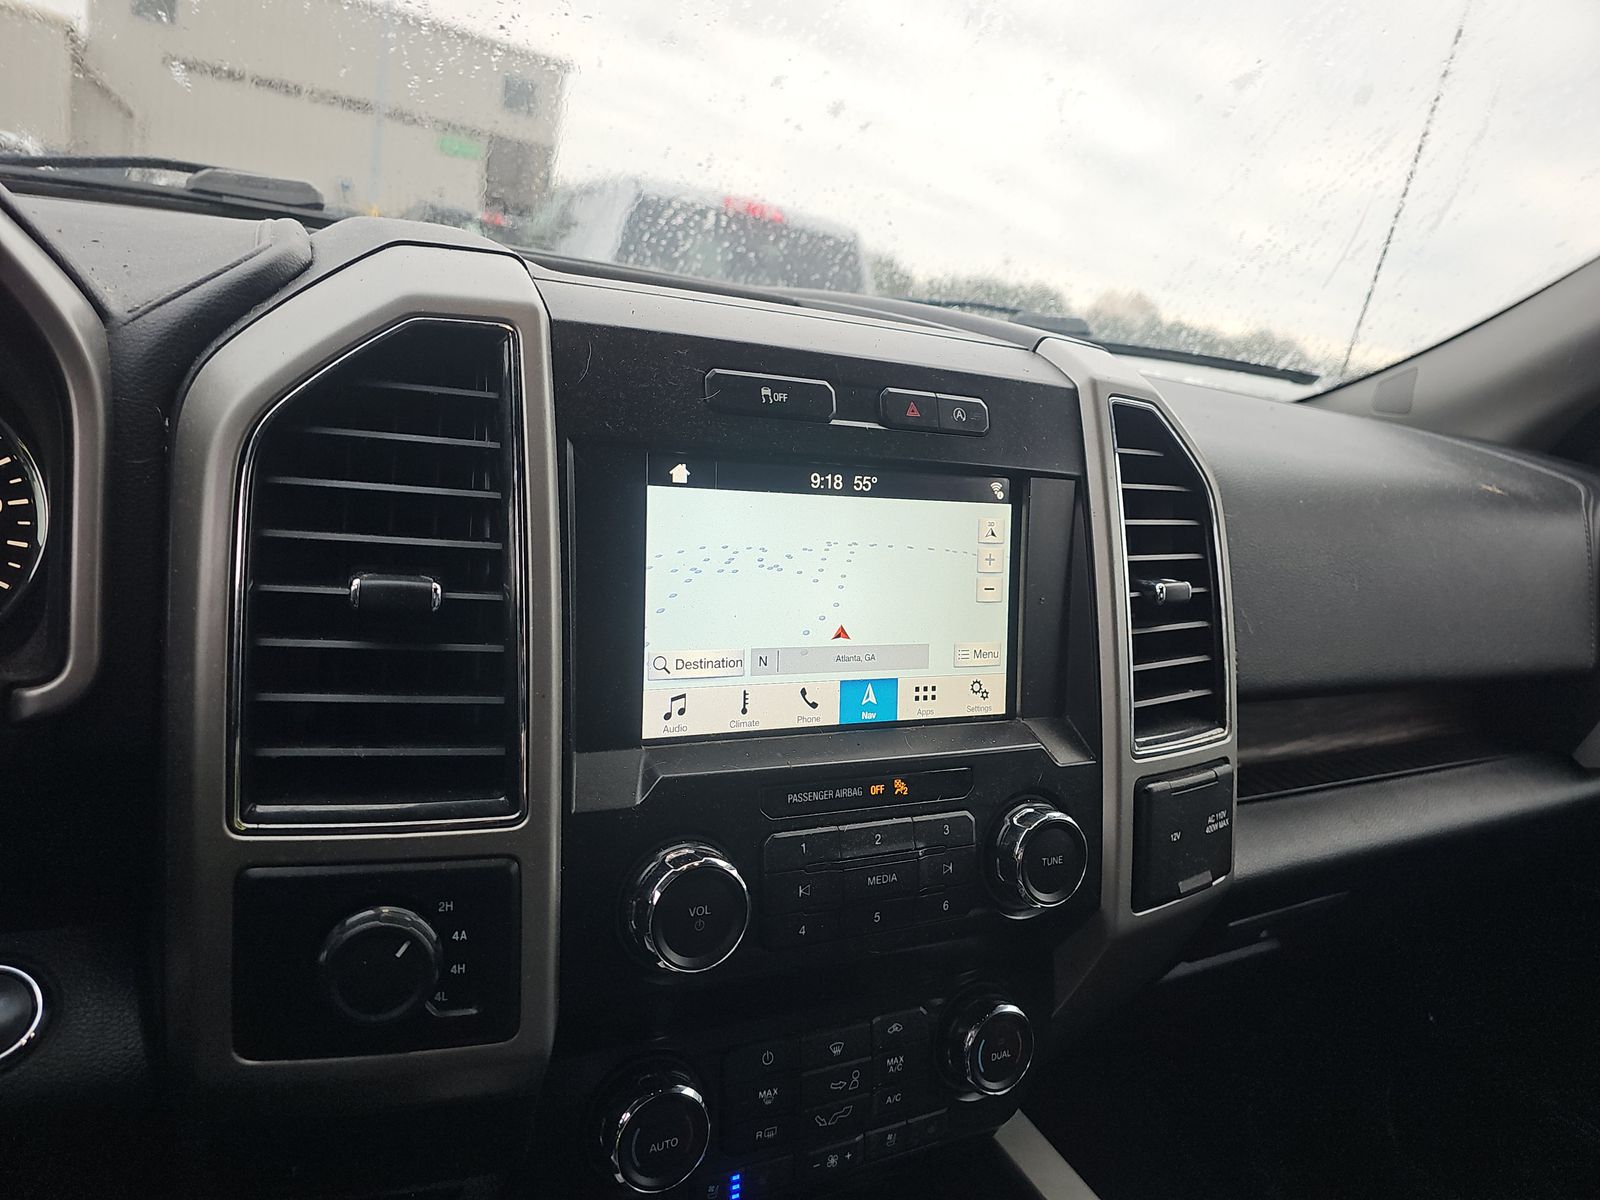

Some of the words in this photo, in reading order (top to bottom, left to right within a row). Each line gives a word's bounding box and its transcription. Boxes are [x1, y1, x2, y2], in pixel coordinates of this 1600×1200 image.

[773, 392, 789, 403] OFF
[810, 473, 844, 491] 9:18
[853, 475, 879, 492] 55°
[835, 653, 863, 663] Atlanta,
[864, 653, 876, 662] GA
[973, 648, 1000, 660] Menu
[675, 657, 743, 671] Destination
[758, 656, 768, 667] N
[916, 707, 935, 717] Apps
[966, 703, 993, 713] Settings
[796, 714, 821, 724] Phone
[861, 711, 877, 720] Nav
[662, 723, 688, 734] Audio
[729, 719, 760, 729] Climate
[787, 789, 835, 804] PASSENGER
[835, 786, 863, 799] AIRBAG
[870, 784, 885, 796] OFF
[1207, 814, 1216, 824] AC
[1215, 809, 1228, 821] 110V
[943, 824, 950, 836] 3
[1218, 818, 1230, 830] MAX
[874, 833, 882, 846] 2
[1170, 831, 1182, 842] 12V
[800, 842, 807, 854] 1
[1041, 855, 1064, 867] TUNE
[867, 872, 898, 886] MEDIA
[438, 901, 454, 912] 2H
[688, 904, 711, 917] VOL
[942, 899, 950, 912] 6
[873, 911, 881, 924] 5
[451, 929, 468, 942] 4A
[798, 924, 807, 937] 4
[450, 963, 466, 975] 4H
[434, 991, 448, 1002] 4L
[990, 1049, 1012, 1063] DUAL
[886, 1057, 905, 1068] MAX
[887, 1063, 904, 1074] A/C
[757, 1088, 779, 1101] MAX
[885, 1092, 902, 1104] A/C
[755, 1129, 763, 1141] R
[649, 1136, 679, 1154] AUTO
